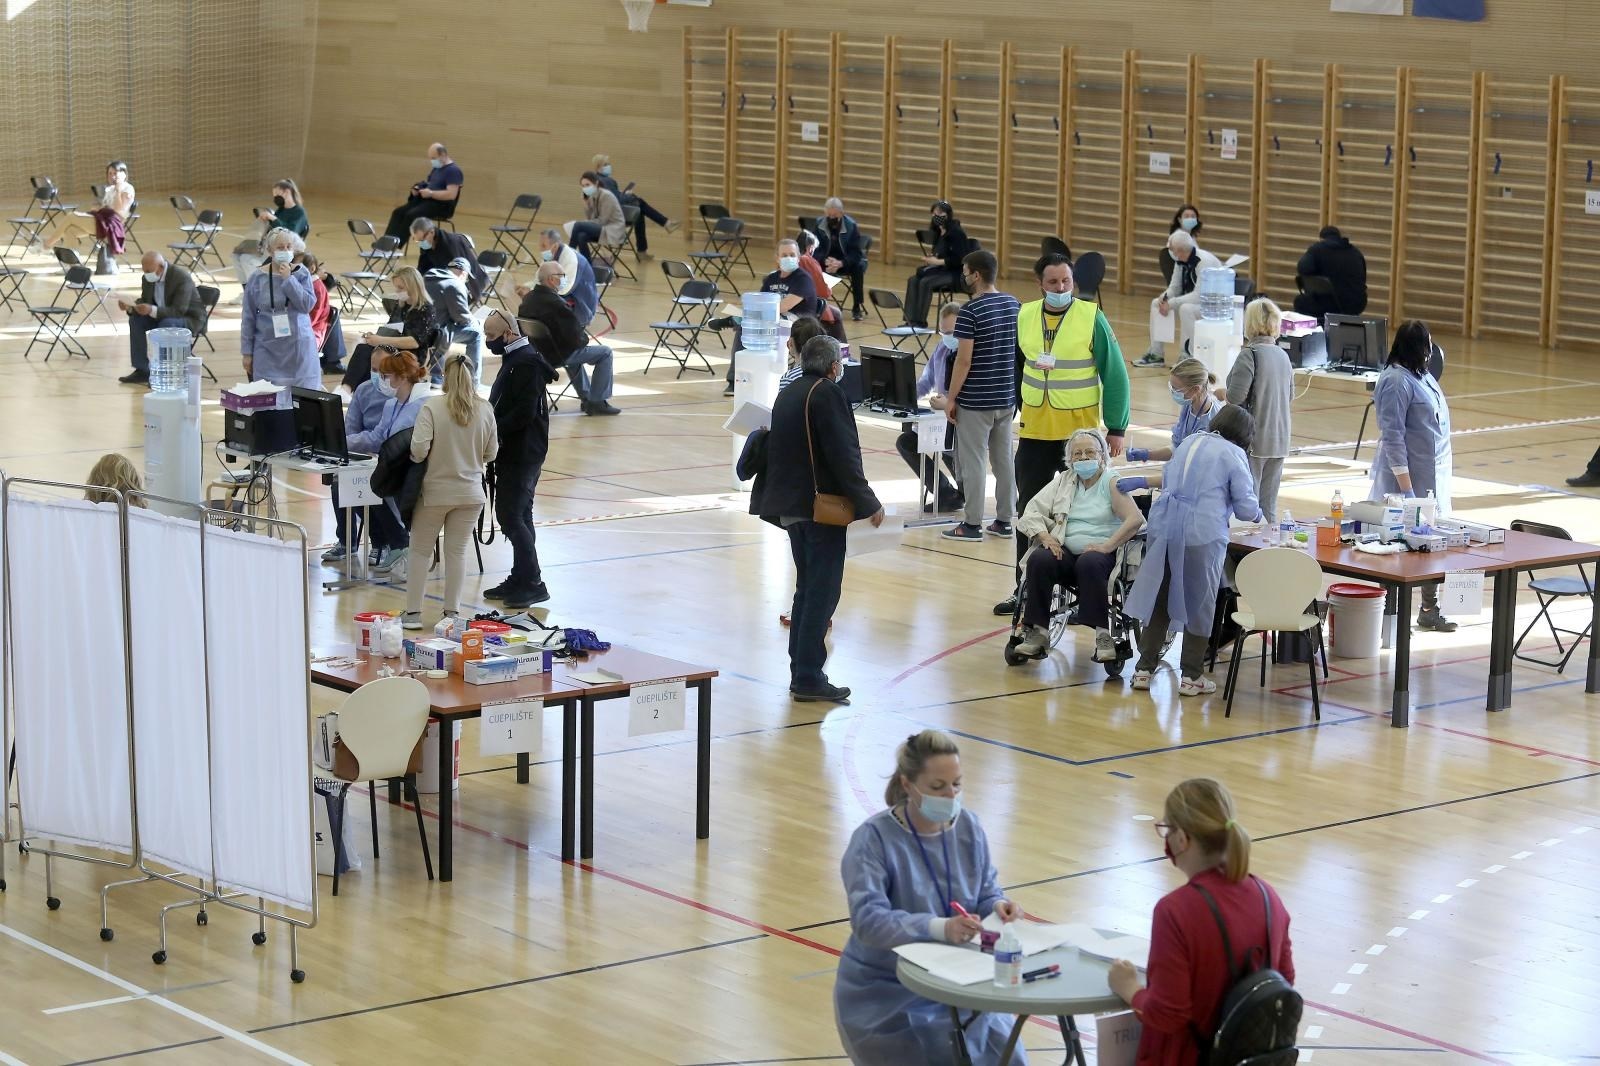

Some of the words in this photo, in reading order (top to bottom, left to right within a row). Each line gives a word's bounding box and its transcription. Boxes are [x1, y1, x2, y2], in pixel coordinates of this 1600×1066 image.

[1588, 198, 1596, 206] 15
[933, 438, 938, 446] 3
[357, 490, 363, 499] 2
[1459, 594, 1464, 604] 3
[512, 656, 540, 664] hirana
[653, 708, 660, 719] 2
[507, 728, 513, 740] 1
